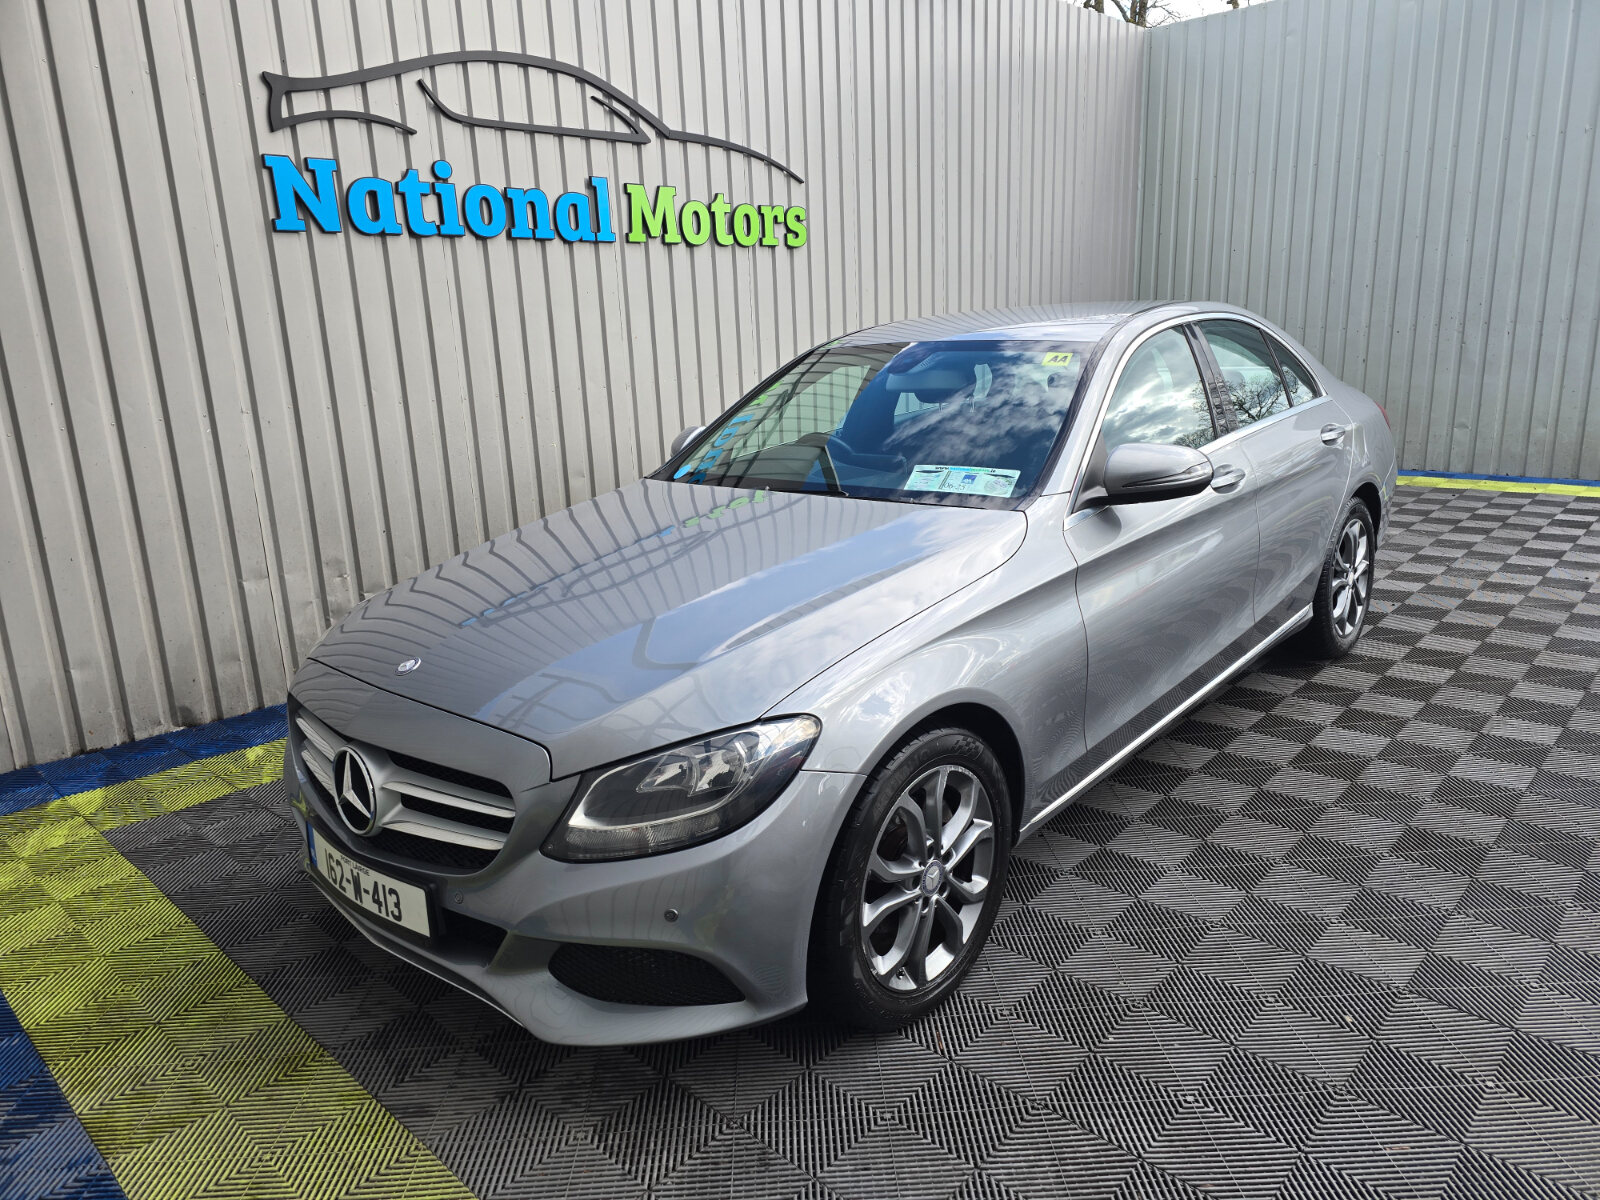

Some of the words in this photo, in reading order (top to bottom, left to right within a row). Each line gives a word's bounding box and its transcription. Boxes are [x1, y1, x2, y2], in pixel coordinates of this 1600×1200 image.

[262, 154, 616, 243] National
[624, 183, 807, 247] Motors
[1047, 355, 1069, 363] AA
[324, 847, 402, 922] 162-W-413
